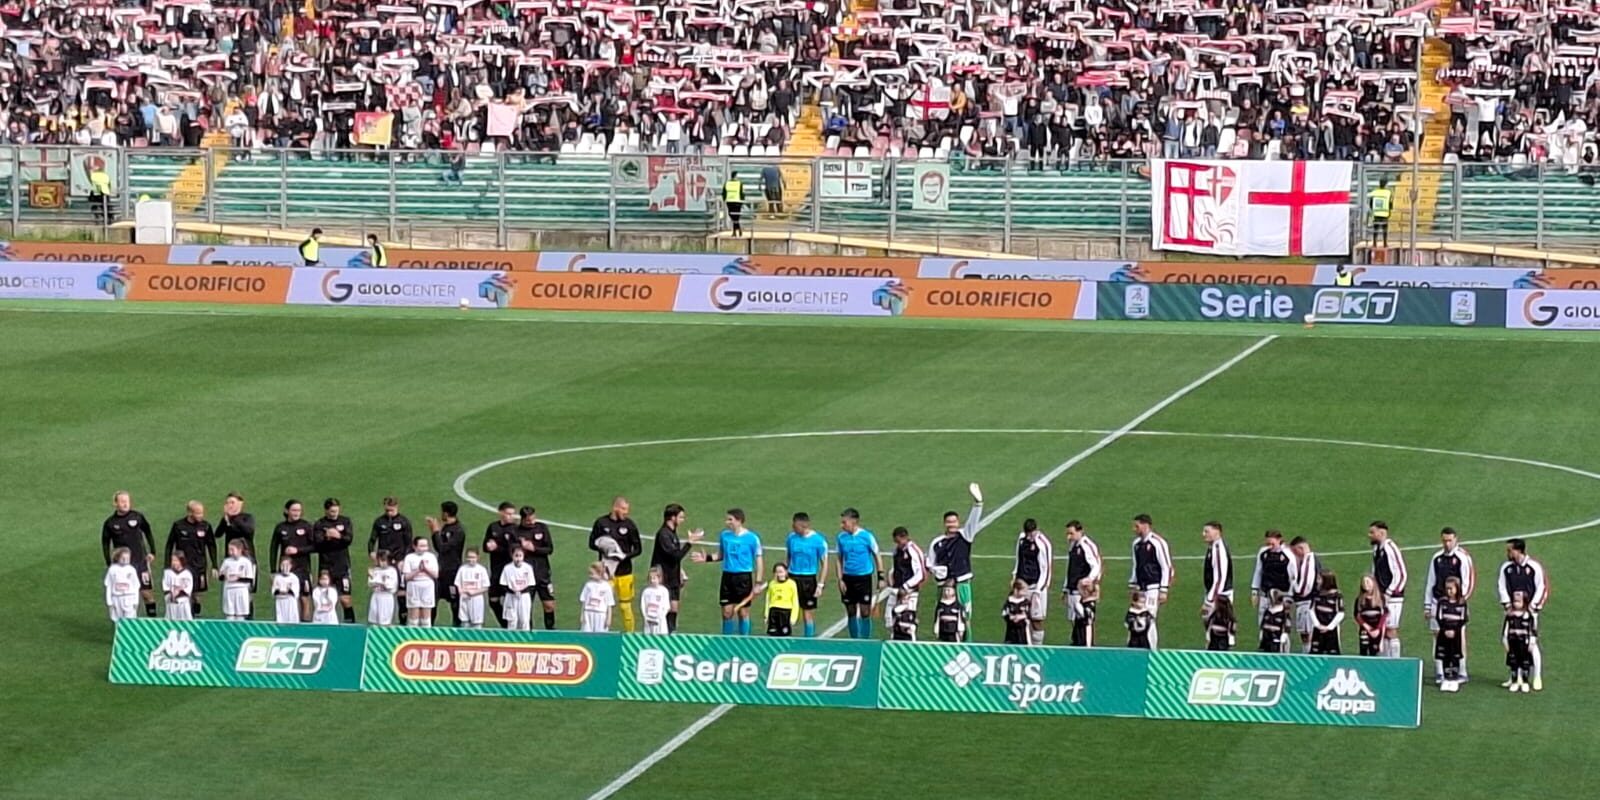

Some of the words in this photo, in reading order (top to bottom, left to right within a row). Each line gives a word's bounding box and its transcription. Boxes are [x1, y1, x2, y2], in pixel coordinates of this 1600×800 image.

[148, 275, 266, 292] COLORIFICIO
[358, 283, 456, 297] GIOLOCENTER
[531, 283, 653, 300] COLORIFICIO
[747, 291, 849, 305] GIOLOCENTER
[926, 290, 1053, 308] COLORIFICIO
[1200, 287, 1294, 318] Serie
[1315, 293, 1394, 317] BKT
[149, 654, 202, 674] Kappa
[240, 644, 322, 668] BKT
[403, 648, 451, 671] OLD
[453, 650, 514, 673] WILD
[515, 651, 583, 676] WEST
[672, 654, 759, 683] Serie
[771, 659, 858, 685] BKT
[982, 654, 1041, 686] Ifis
[1008, 681, 1084, 708] sport
[1192, 675, 1279, 700] BKT
[1316, 694, 1376, 715] Kappa
